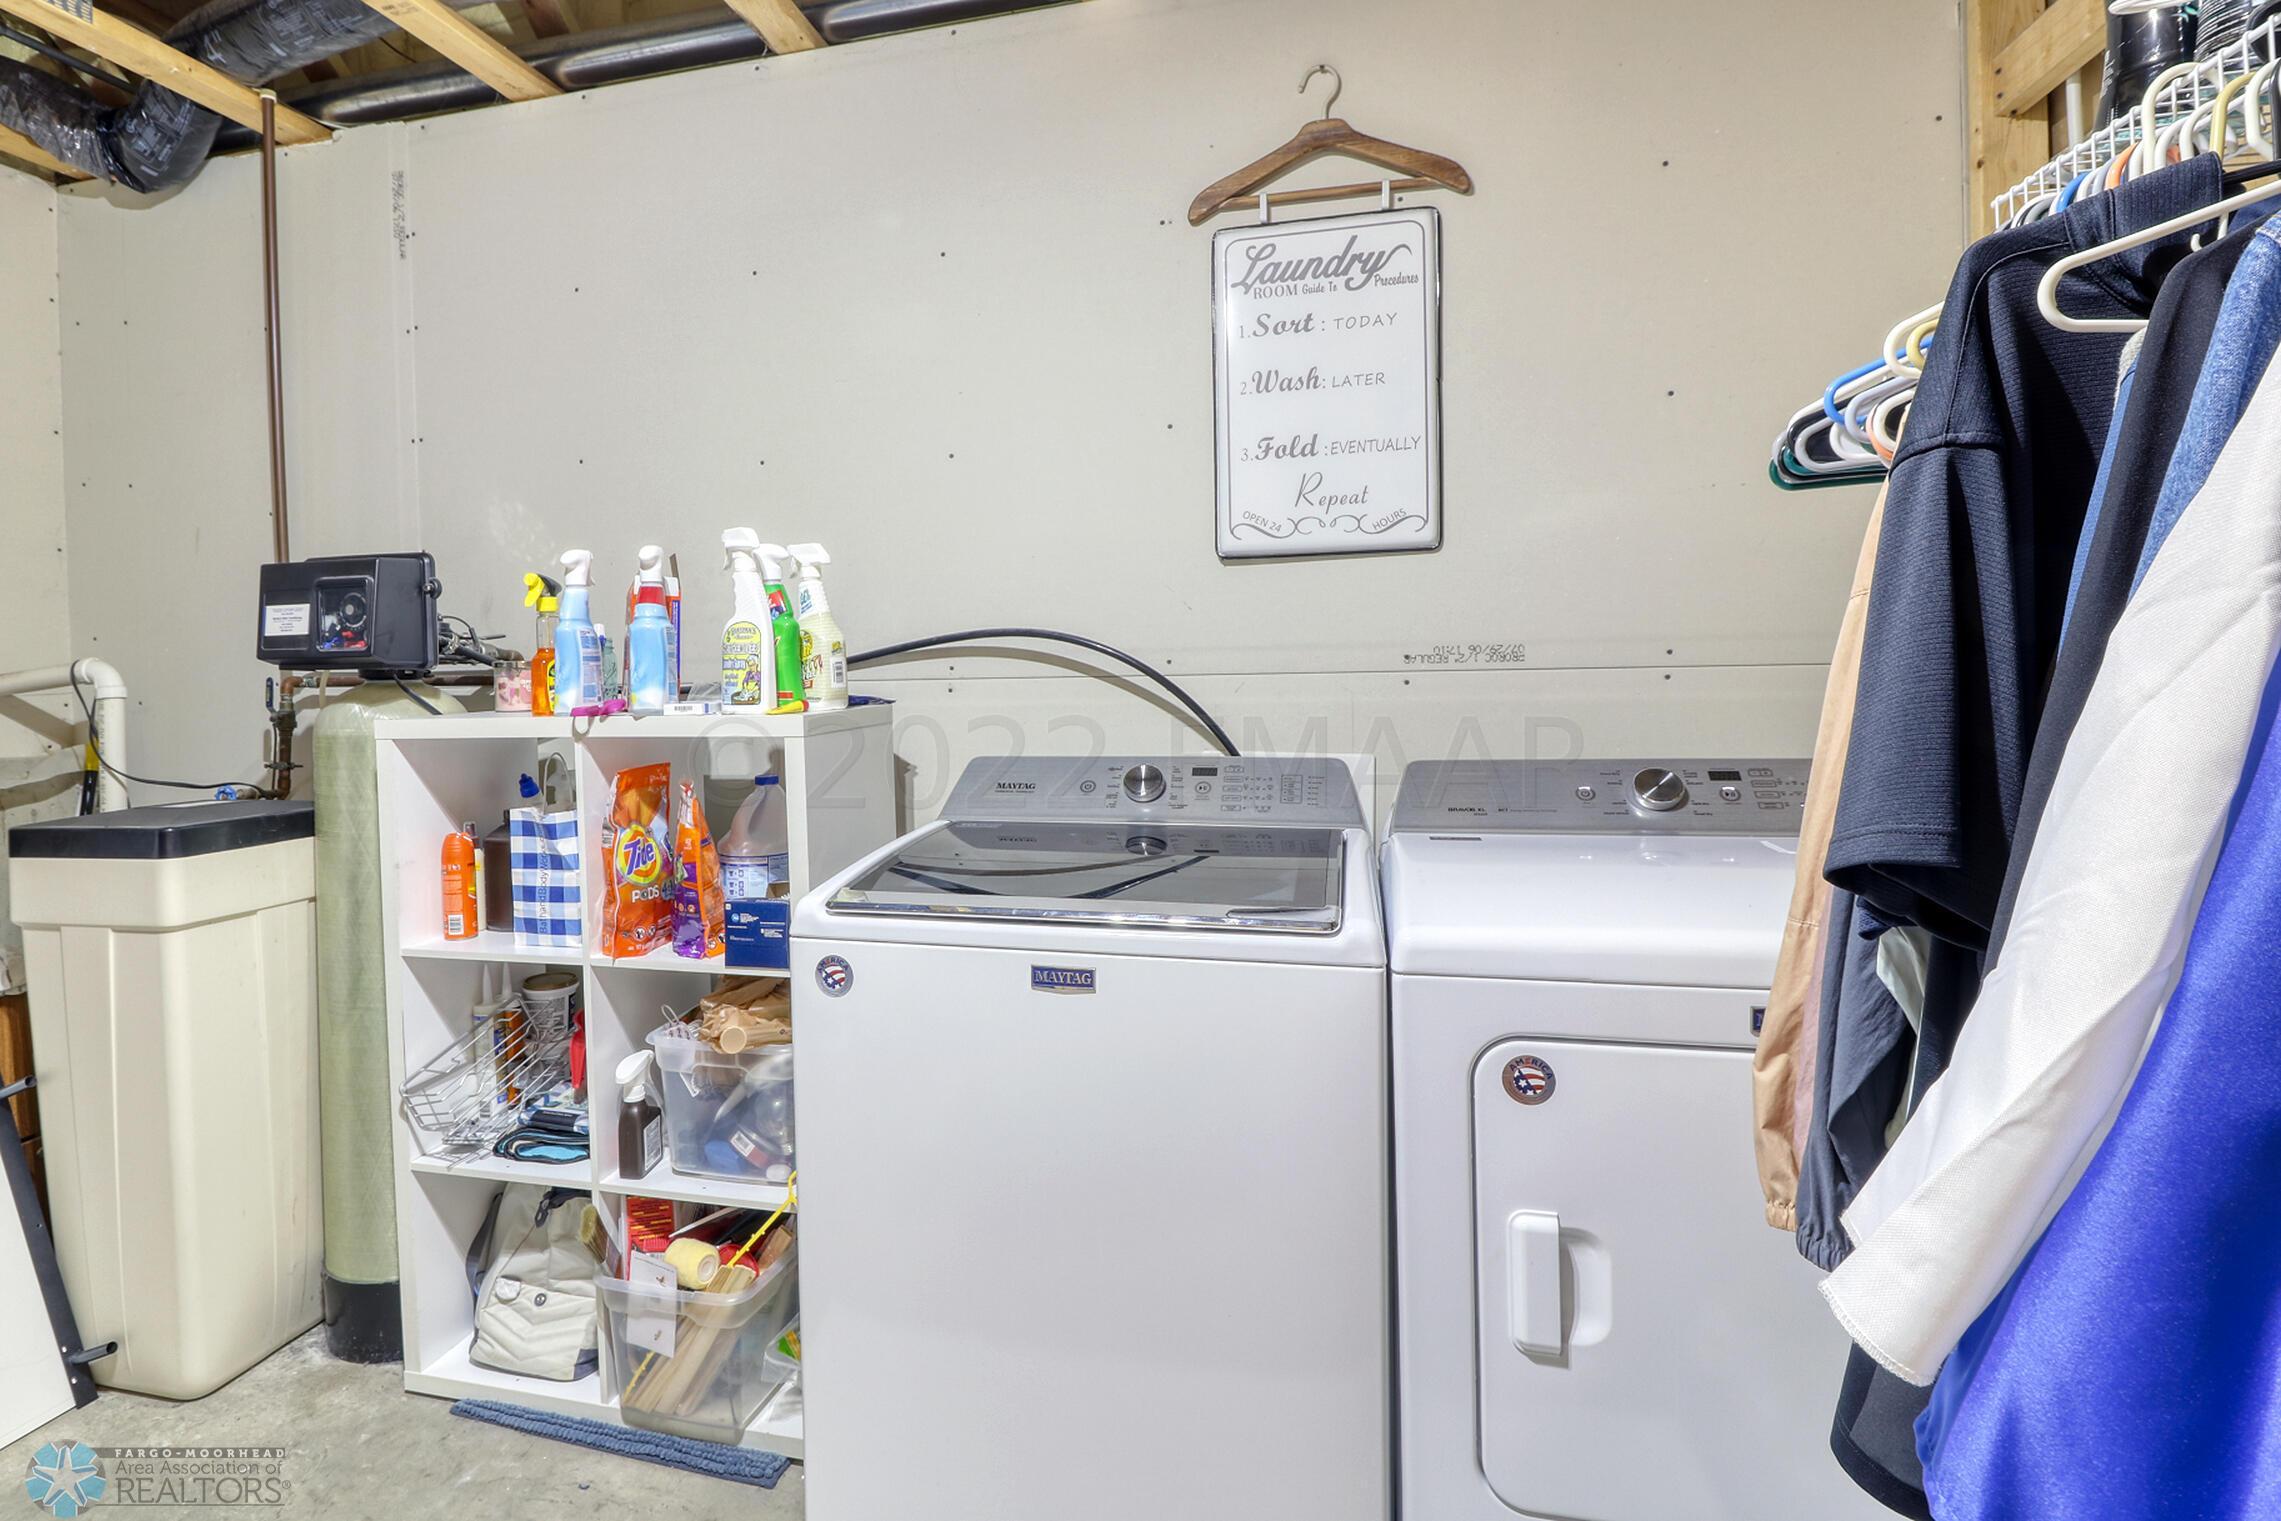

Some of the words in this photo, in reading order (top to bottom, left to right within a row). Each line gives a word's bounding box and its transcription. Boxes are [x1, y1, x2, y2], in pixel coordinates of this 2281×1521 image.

[1231, 235, 1412, 294] Laundry
[1373, 272, 1419, 287] Procedures
[1253, 284, 1298, 299] ROOM
[1302, 283, 1324, 295] Guide
[1329, 281, 1338, 292] To
[1333, 312, 1398, 330] TODAY
[1332, 372, 1386, 388] LATER
[1295, 471, 1369, 515] Repeat
[1242, 510, 1267, 527] OPEN
[1268, 521, 1282, 533] 24
[1371, 508, 1408, 531] HOURS
[995, 782, 1036, 790] MAYTAG
[624, 838, 655, 875] Tide
[632, 885, 659, 903] PODS
[1033, 970, 1092, 985] MAYTAG
